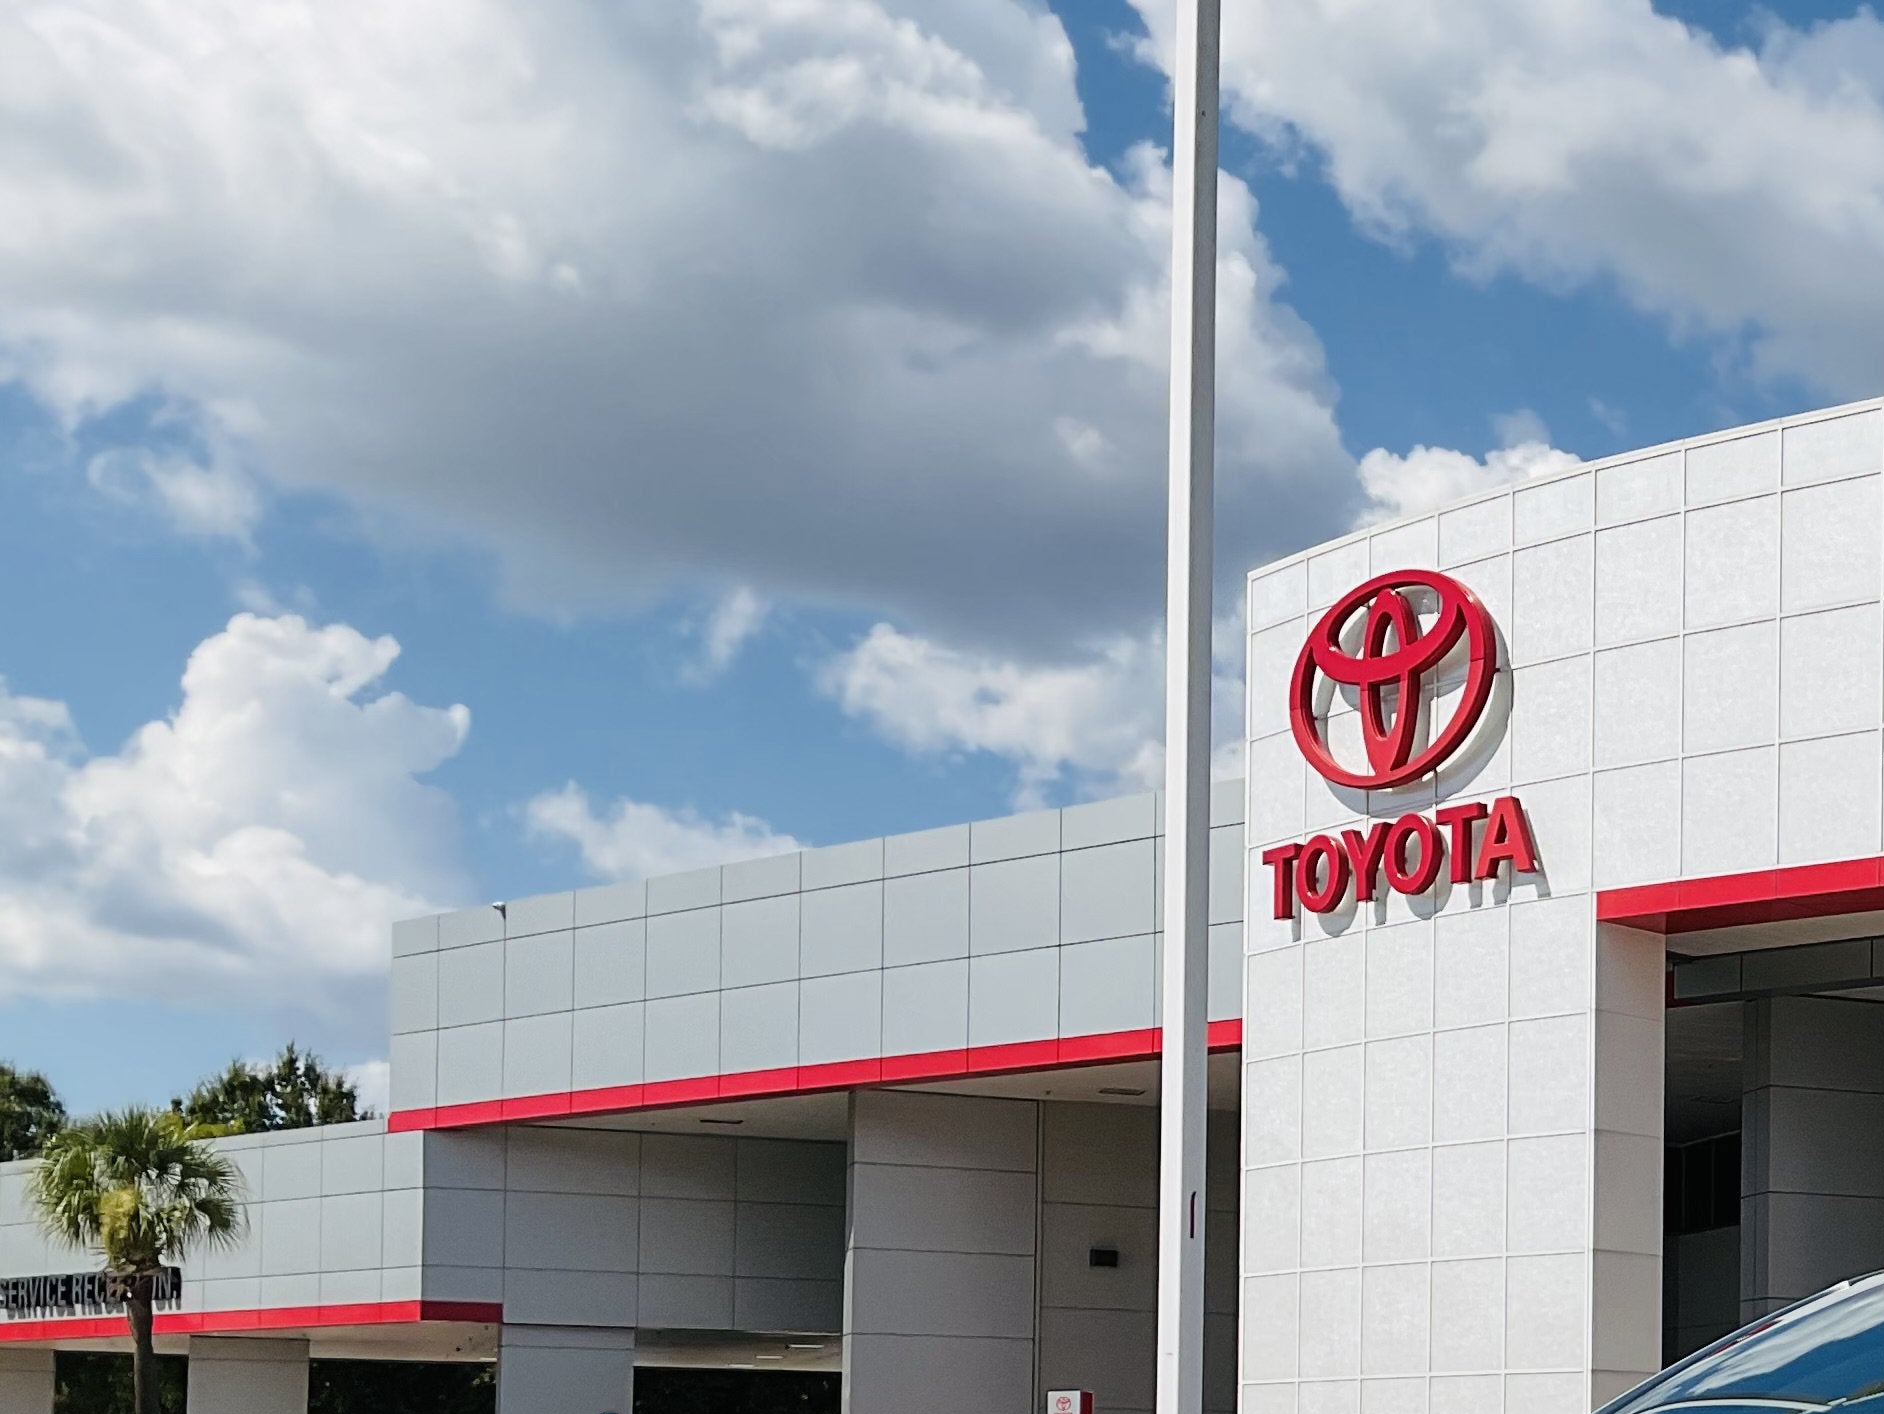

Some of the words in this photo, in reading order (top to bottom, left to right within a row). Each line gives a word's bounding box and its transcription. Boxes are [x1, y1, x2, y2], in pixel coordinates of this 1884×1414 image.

[1262, 796, 1539, 920] TOYOTA
[0, 1274, 67, 1308] SERVICE
[72, 1267, 172, 1302] RECEN
